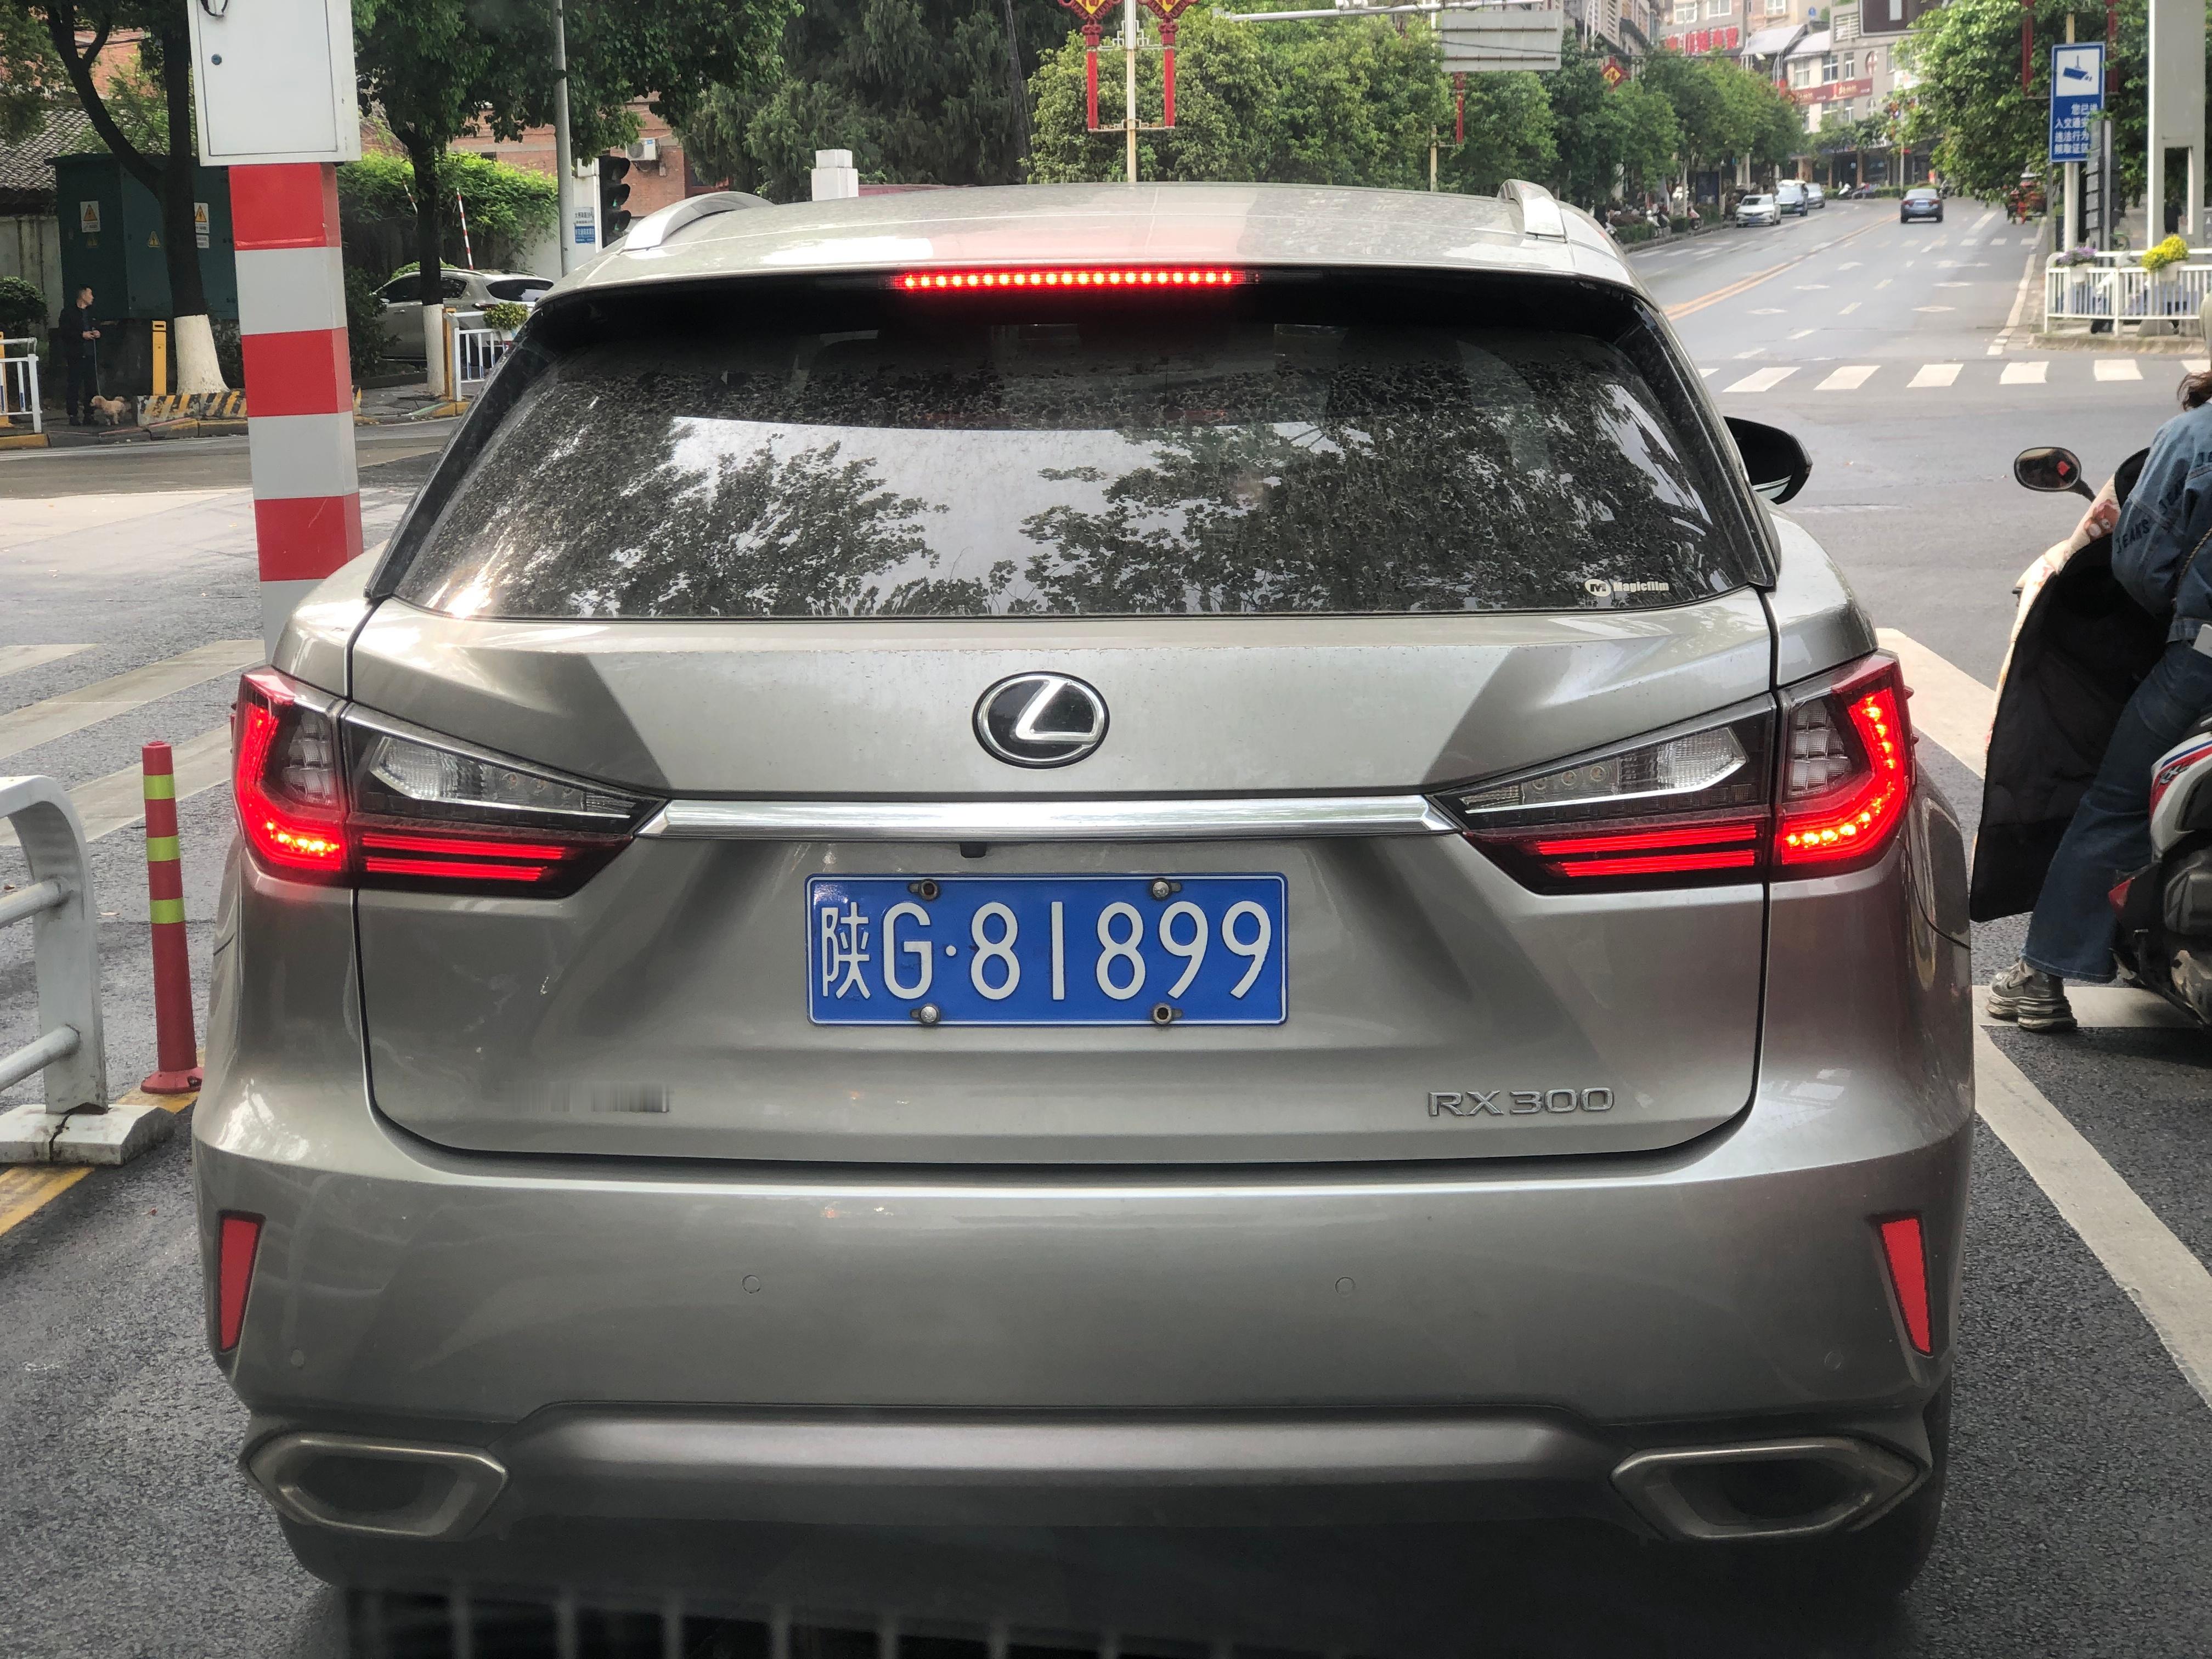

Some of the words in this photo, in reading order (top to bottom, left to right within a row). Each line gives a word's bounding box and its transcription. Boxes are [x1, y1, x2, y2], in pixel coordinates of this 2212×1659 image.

[2055, 131, 2090, 142] 违法行为
[1613, 581, 1669, 592] Magicfilm
[1428, 1090, 1504, 1116] RX
[1509, 1087, 1615, 1115] 300
